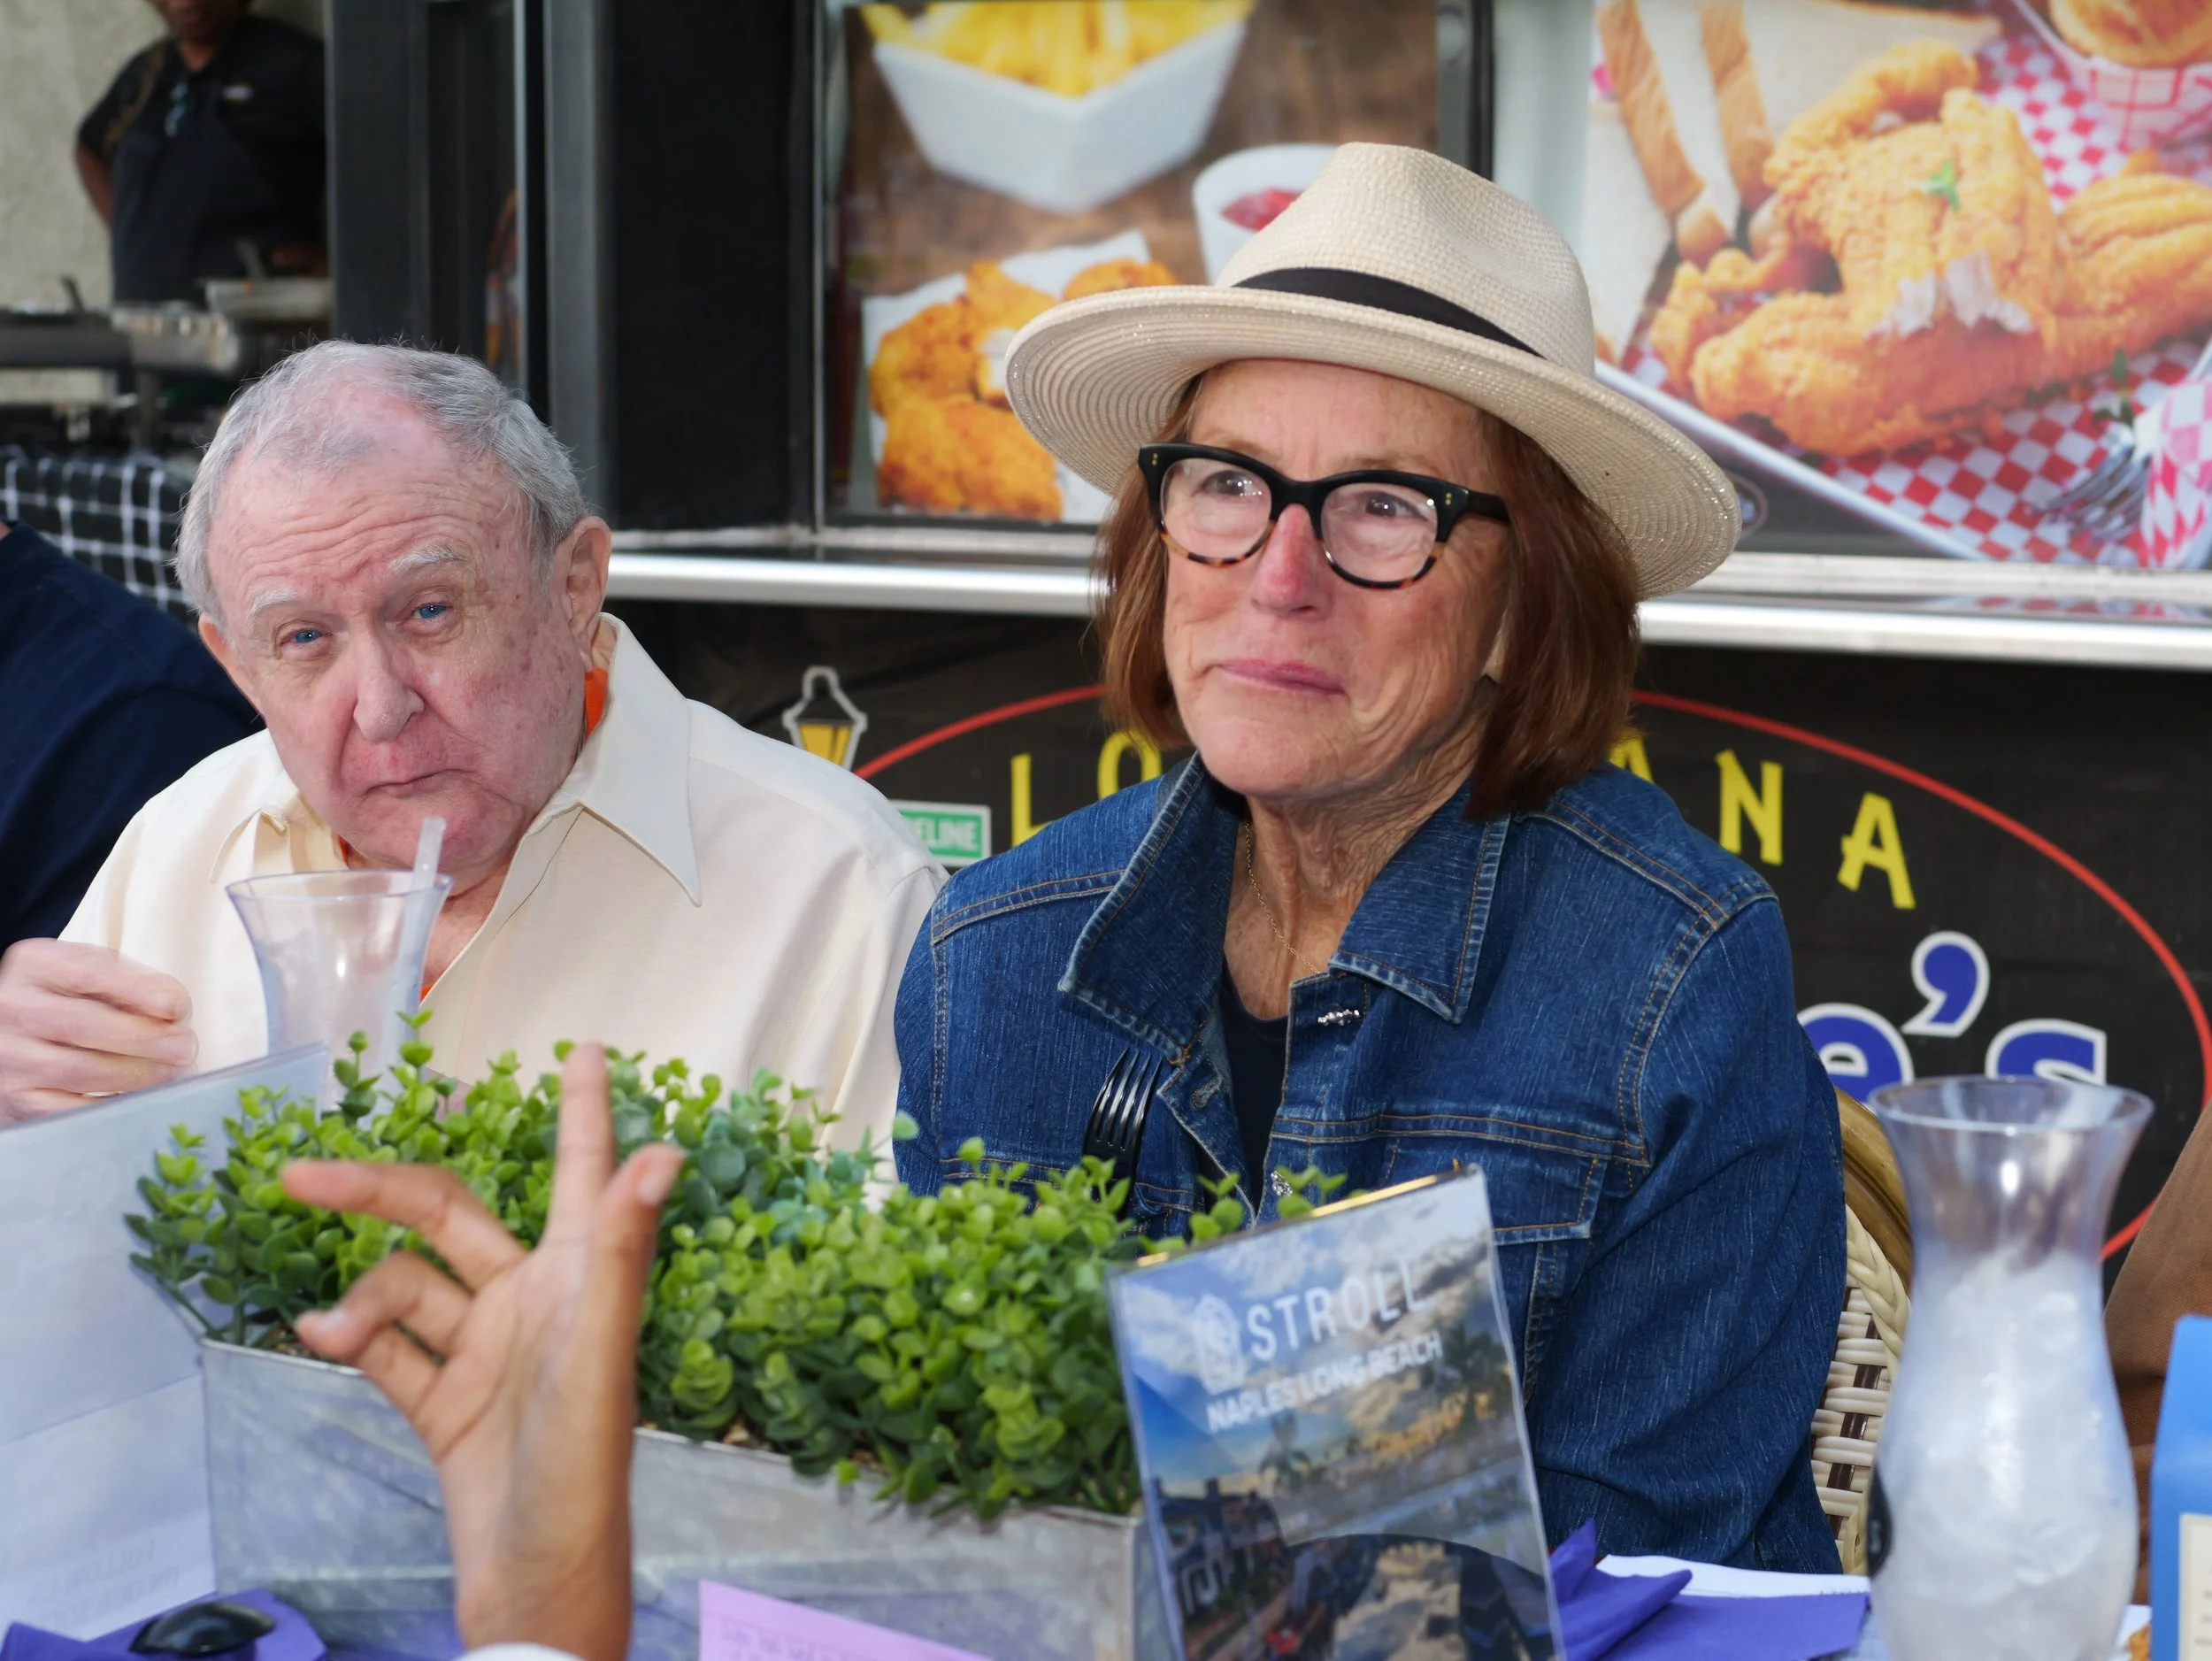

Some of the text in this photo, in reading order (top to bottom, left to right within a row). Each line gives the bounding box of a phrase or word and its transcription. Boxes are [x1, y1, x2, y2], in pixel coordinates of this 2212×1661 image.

[1247, 1260, 1436, 1362] STROLL
[1205, 1328, 1444, 1434] NAPLES LONG BEACH
